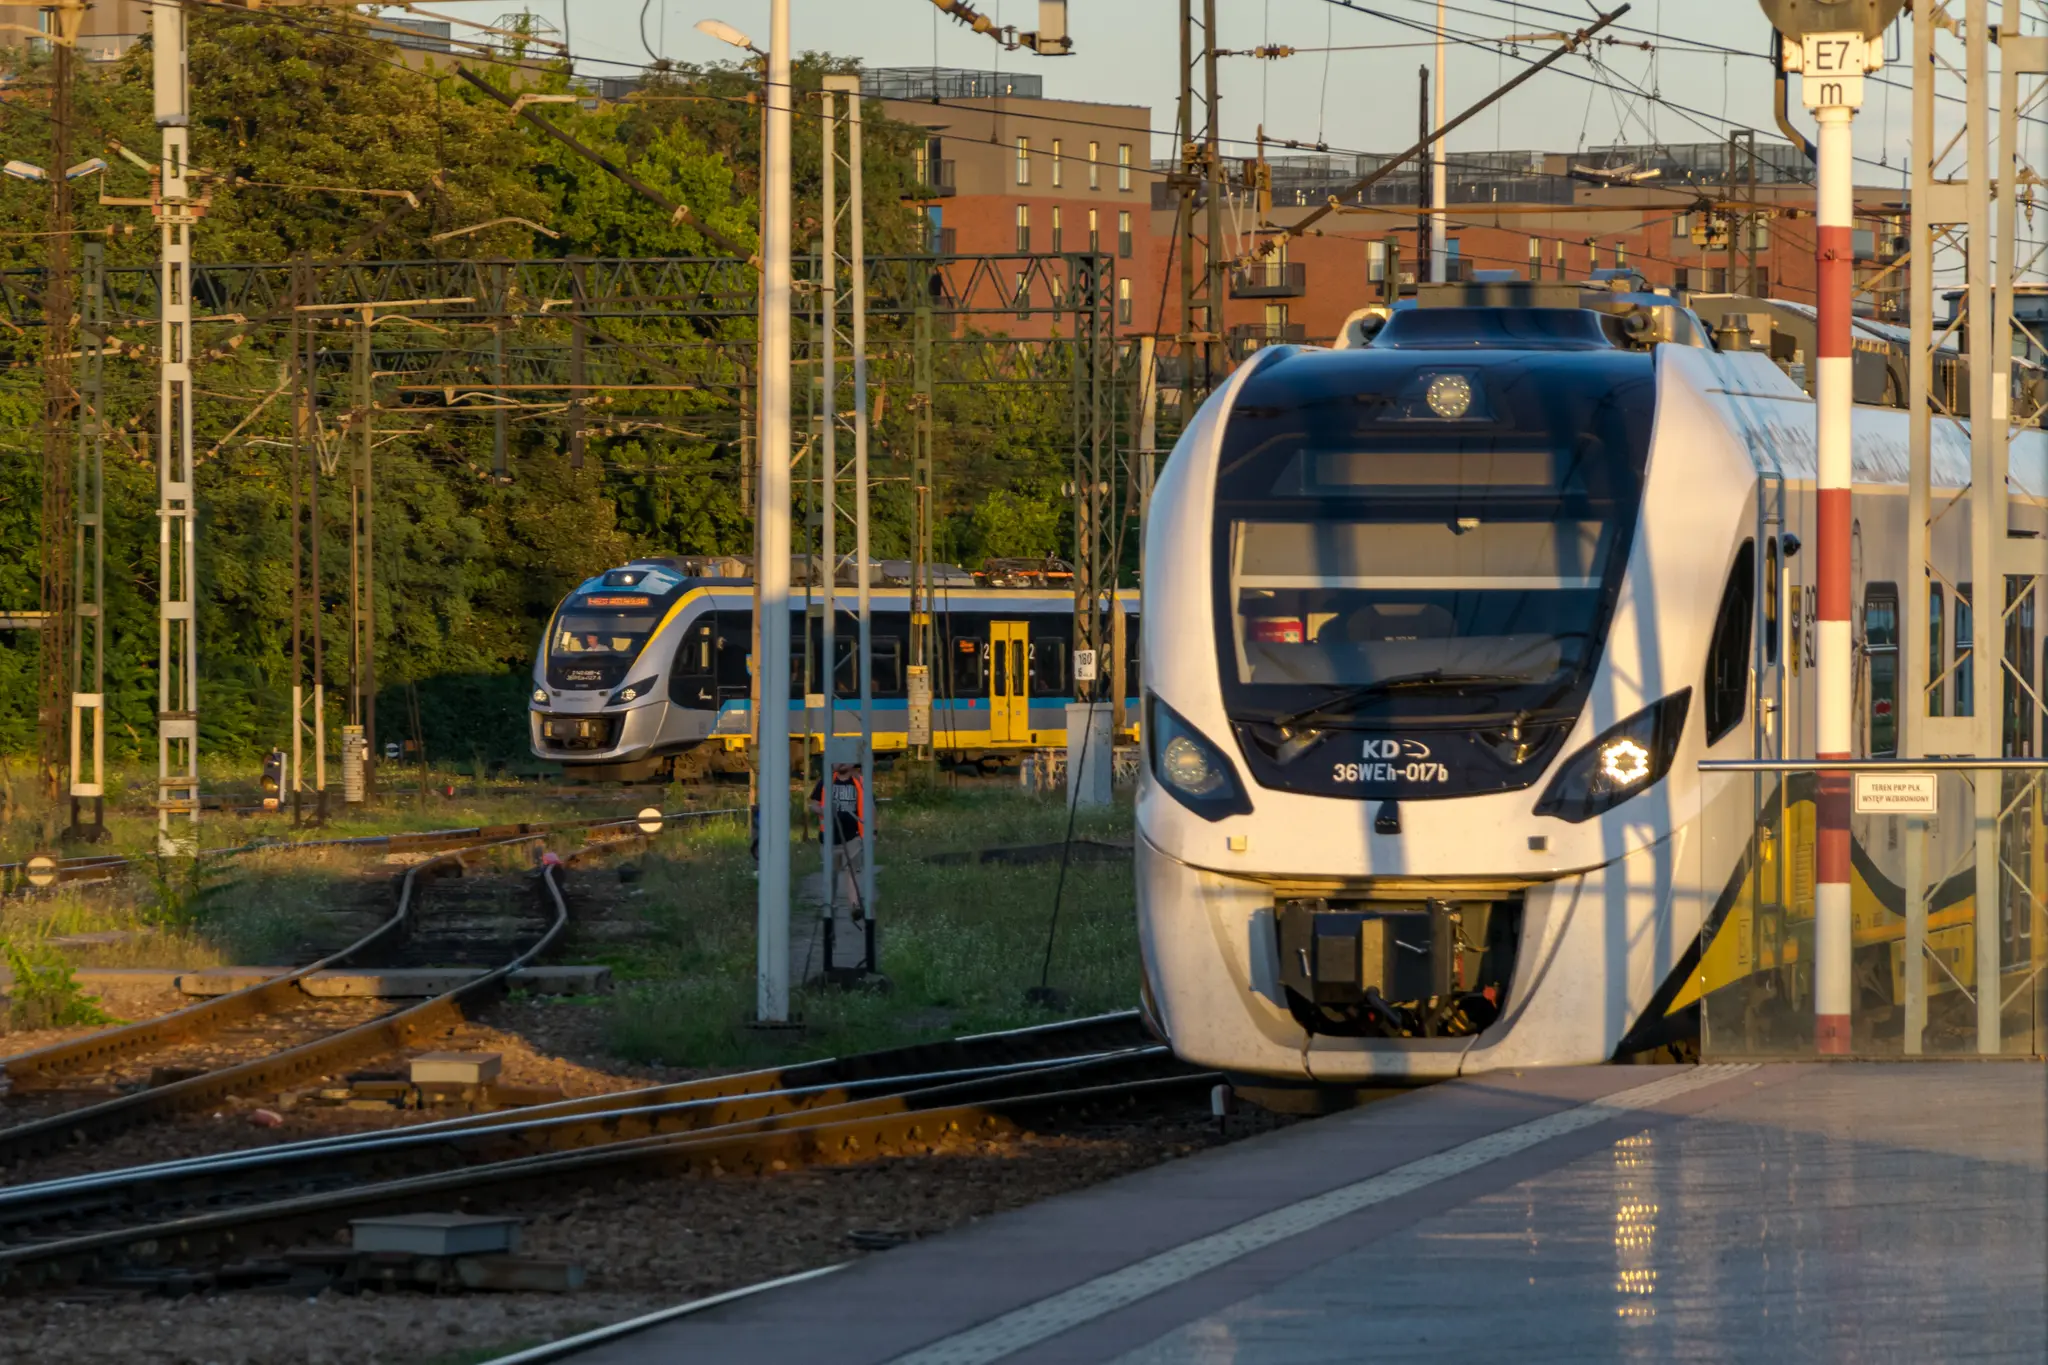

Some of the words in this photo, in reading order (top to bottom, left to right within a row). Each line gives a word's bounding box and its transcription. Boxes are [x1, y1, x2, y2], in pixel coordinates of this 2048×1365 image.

[1816, 41, 1850, 70] E7
[1820, 83, 1842, 104] m
[983, 643, 990, 659] 2
[1029, 643, 1035, 659] 2
[1871, 783, 1892, 792] TEREN
[1893, 784, 1907, 792] PKP
[1907, 784, 1920, 792] PLK
[1862, 795, 1884, 804] WSTĘP
[1885, 795, 1929, 803] WZBRONIONY
